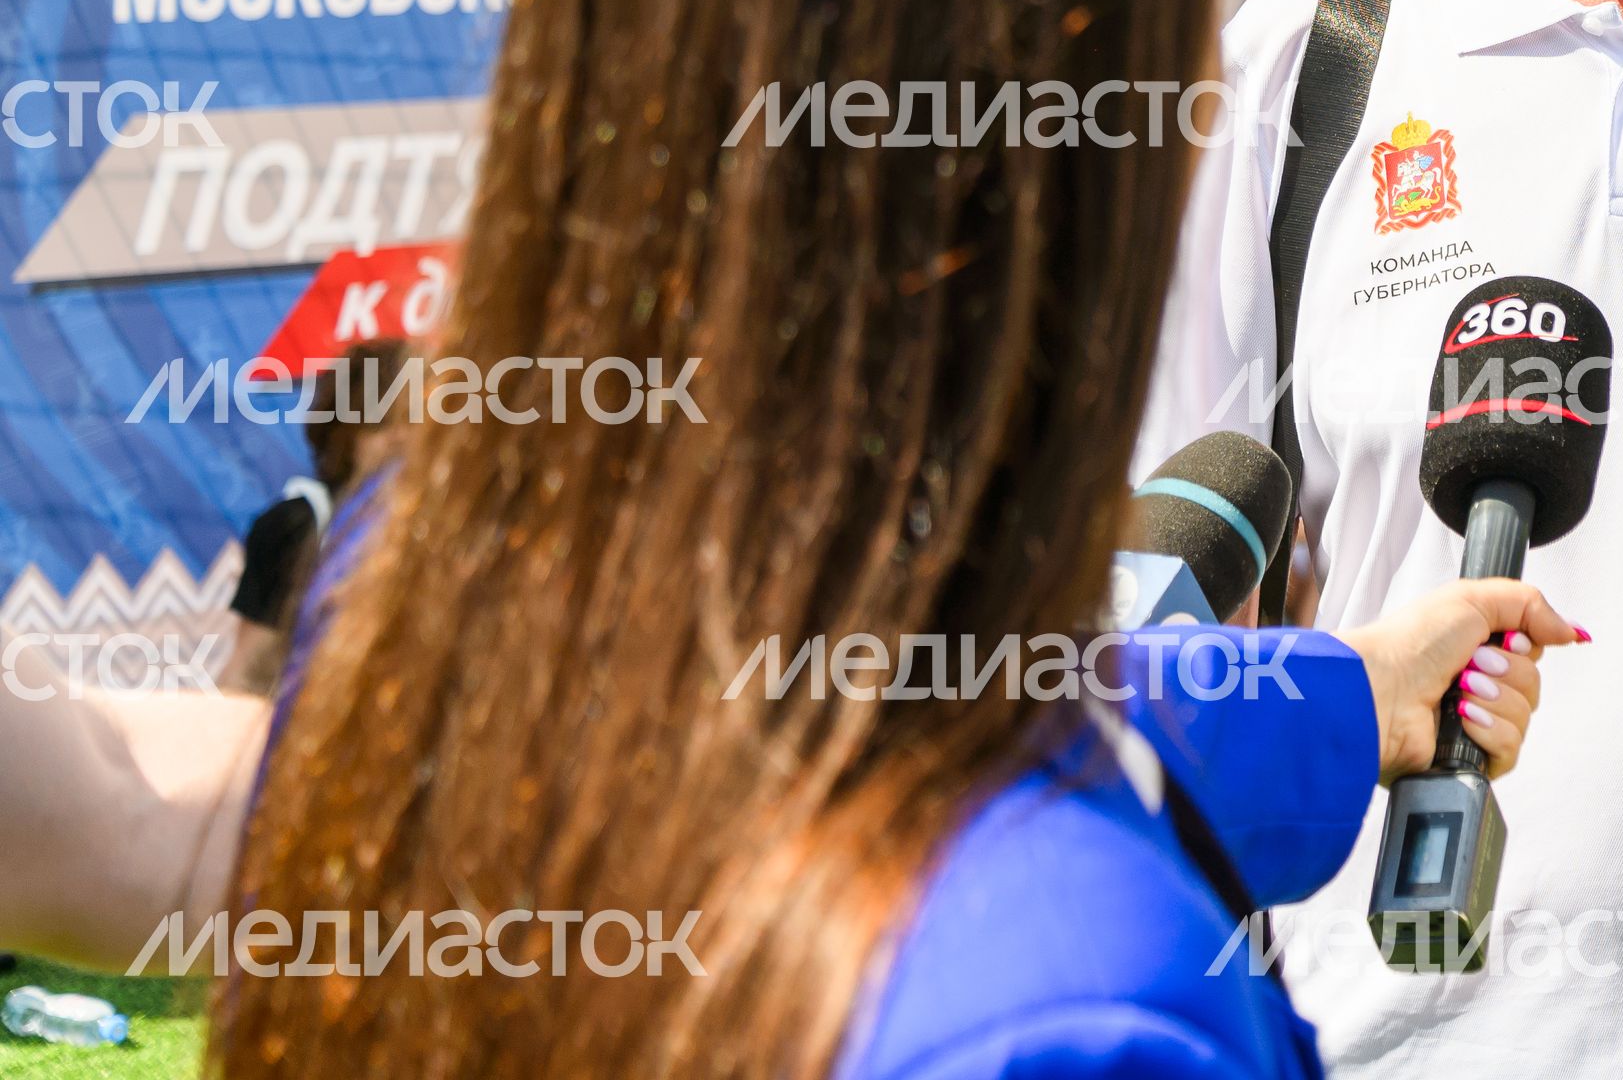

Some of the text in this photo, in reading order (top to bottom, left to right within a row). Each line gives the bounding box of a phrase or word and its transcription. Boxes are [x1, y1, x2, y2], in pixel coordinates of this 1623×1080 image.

[1370, 240, 1474, 275] КОМАНДА
[402, 256, 455, 338] д
[1353, 261, 1496, 306] ГУБЕРНАТОРА
[1457, 298, 1567, 343] 360
